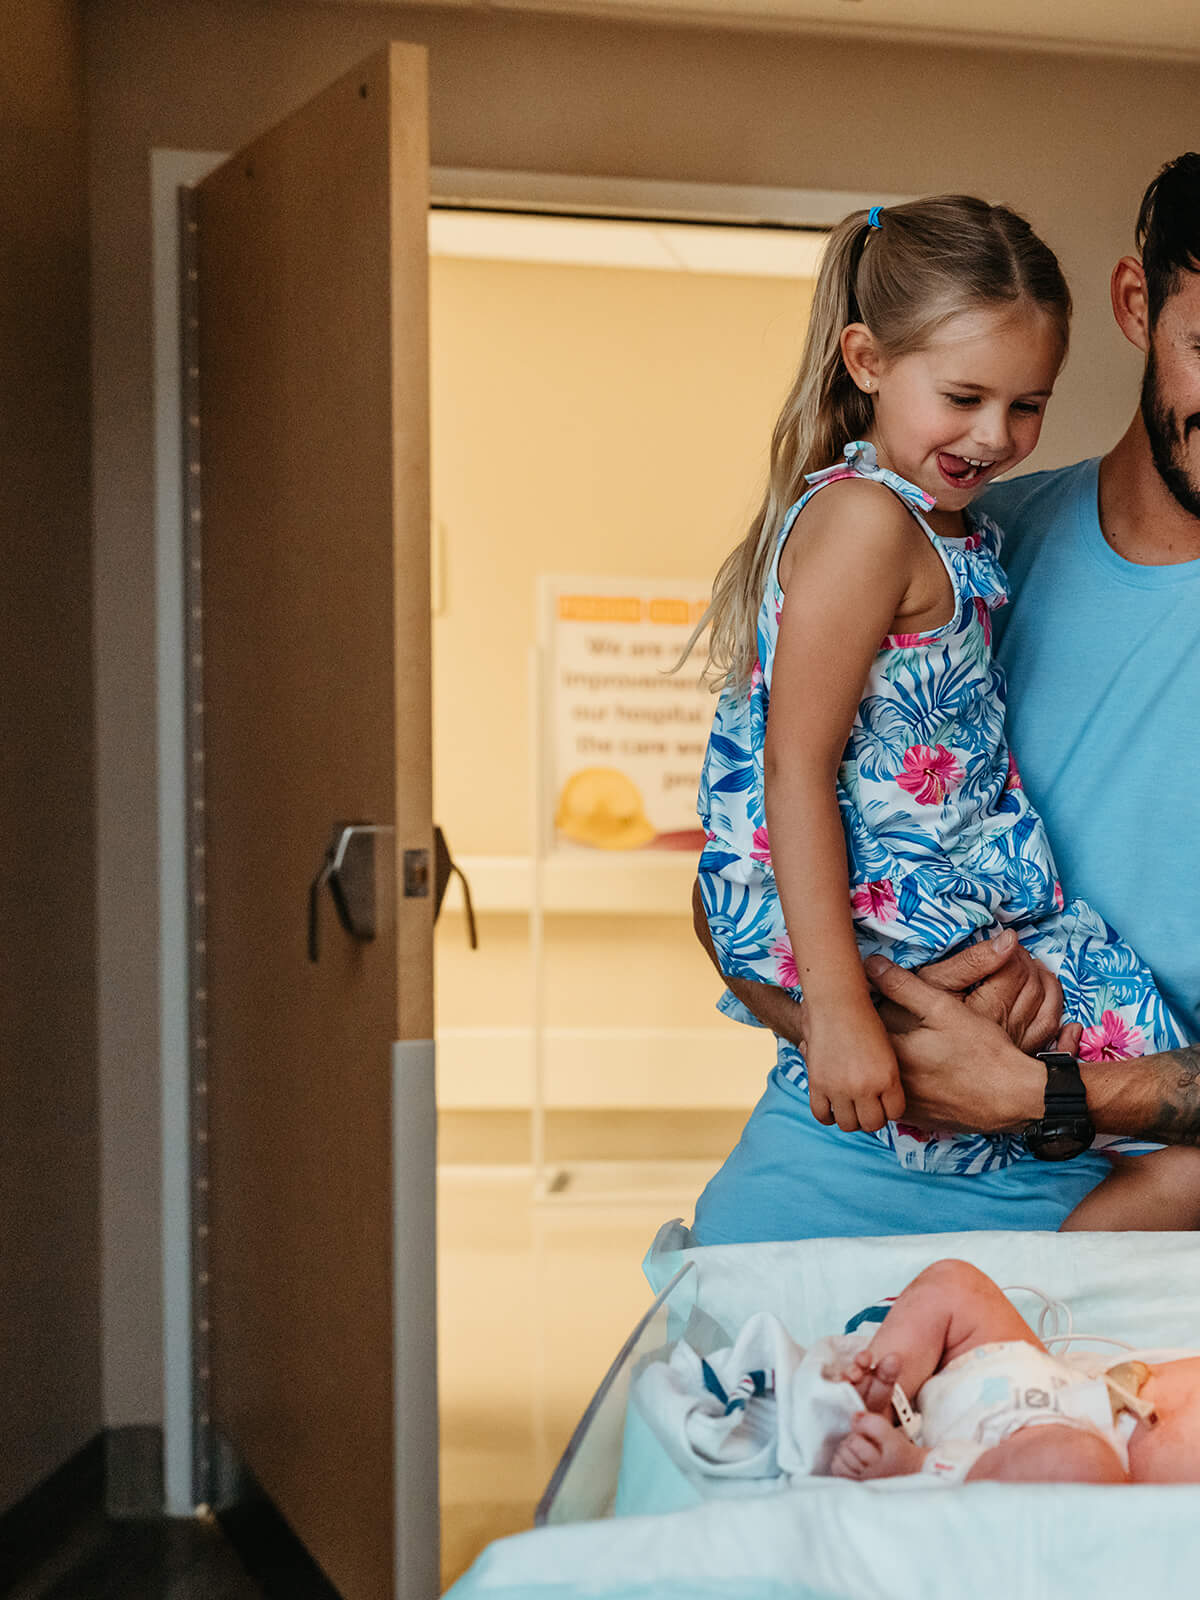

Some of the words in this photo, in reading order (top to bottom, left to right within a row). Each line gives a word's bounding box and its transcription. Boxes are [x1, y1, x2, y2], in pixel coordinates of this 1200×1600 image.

[587, 638, 620, 657] We
[631, 641, 662, 658] are
[572, 705, 606, 721] our
[614, 702, 702, 724] hospital
[576, 735, 612, 754] the
[622, 739, 667, 756] care
